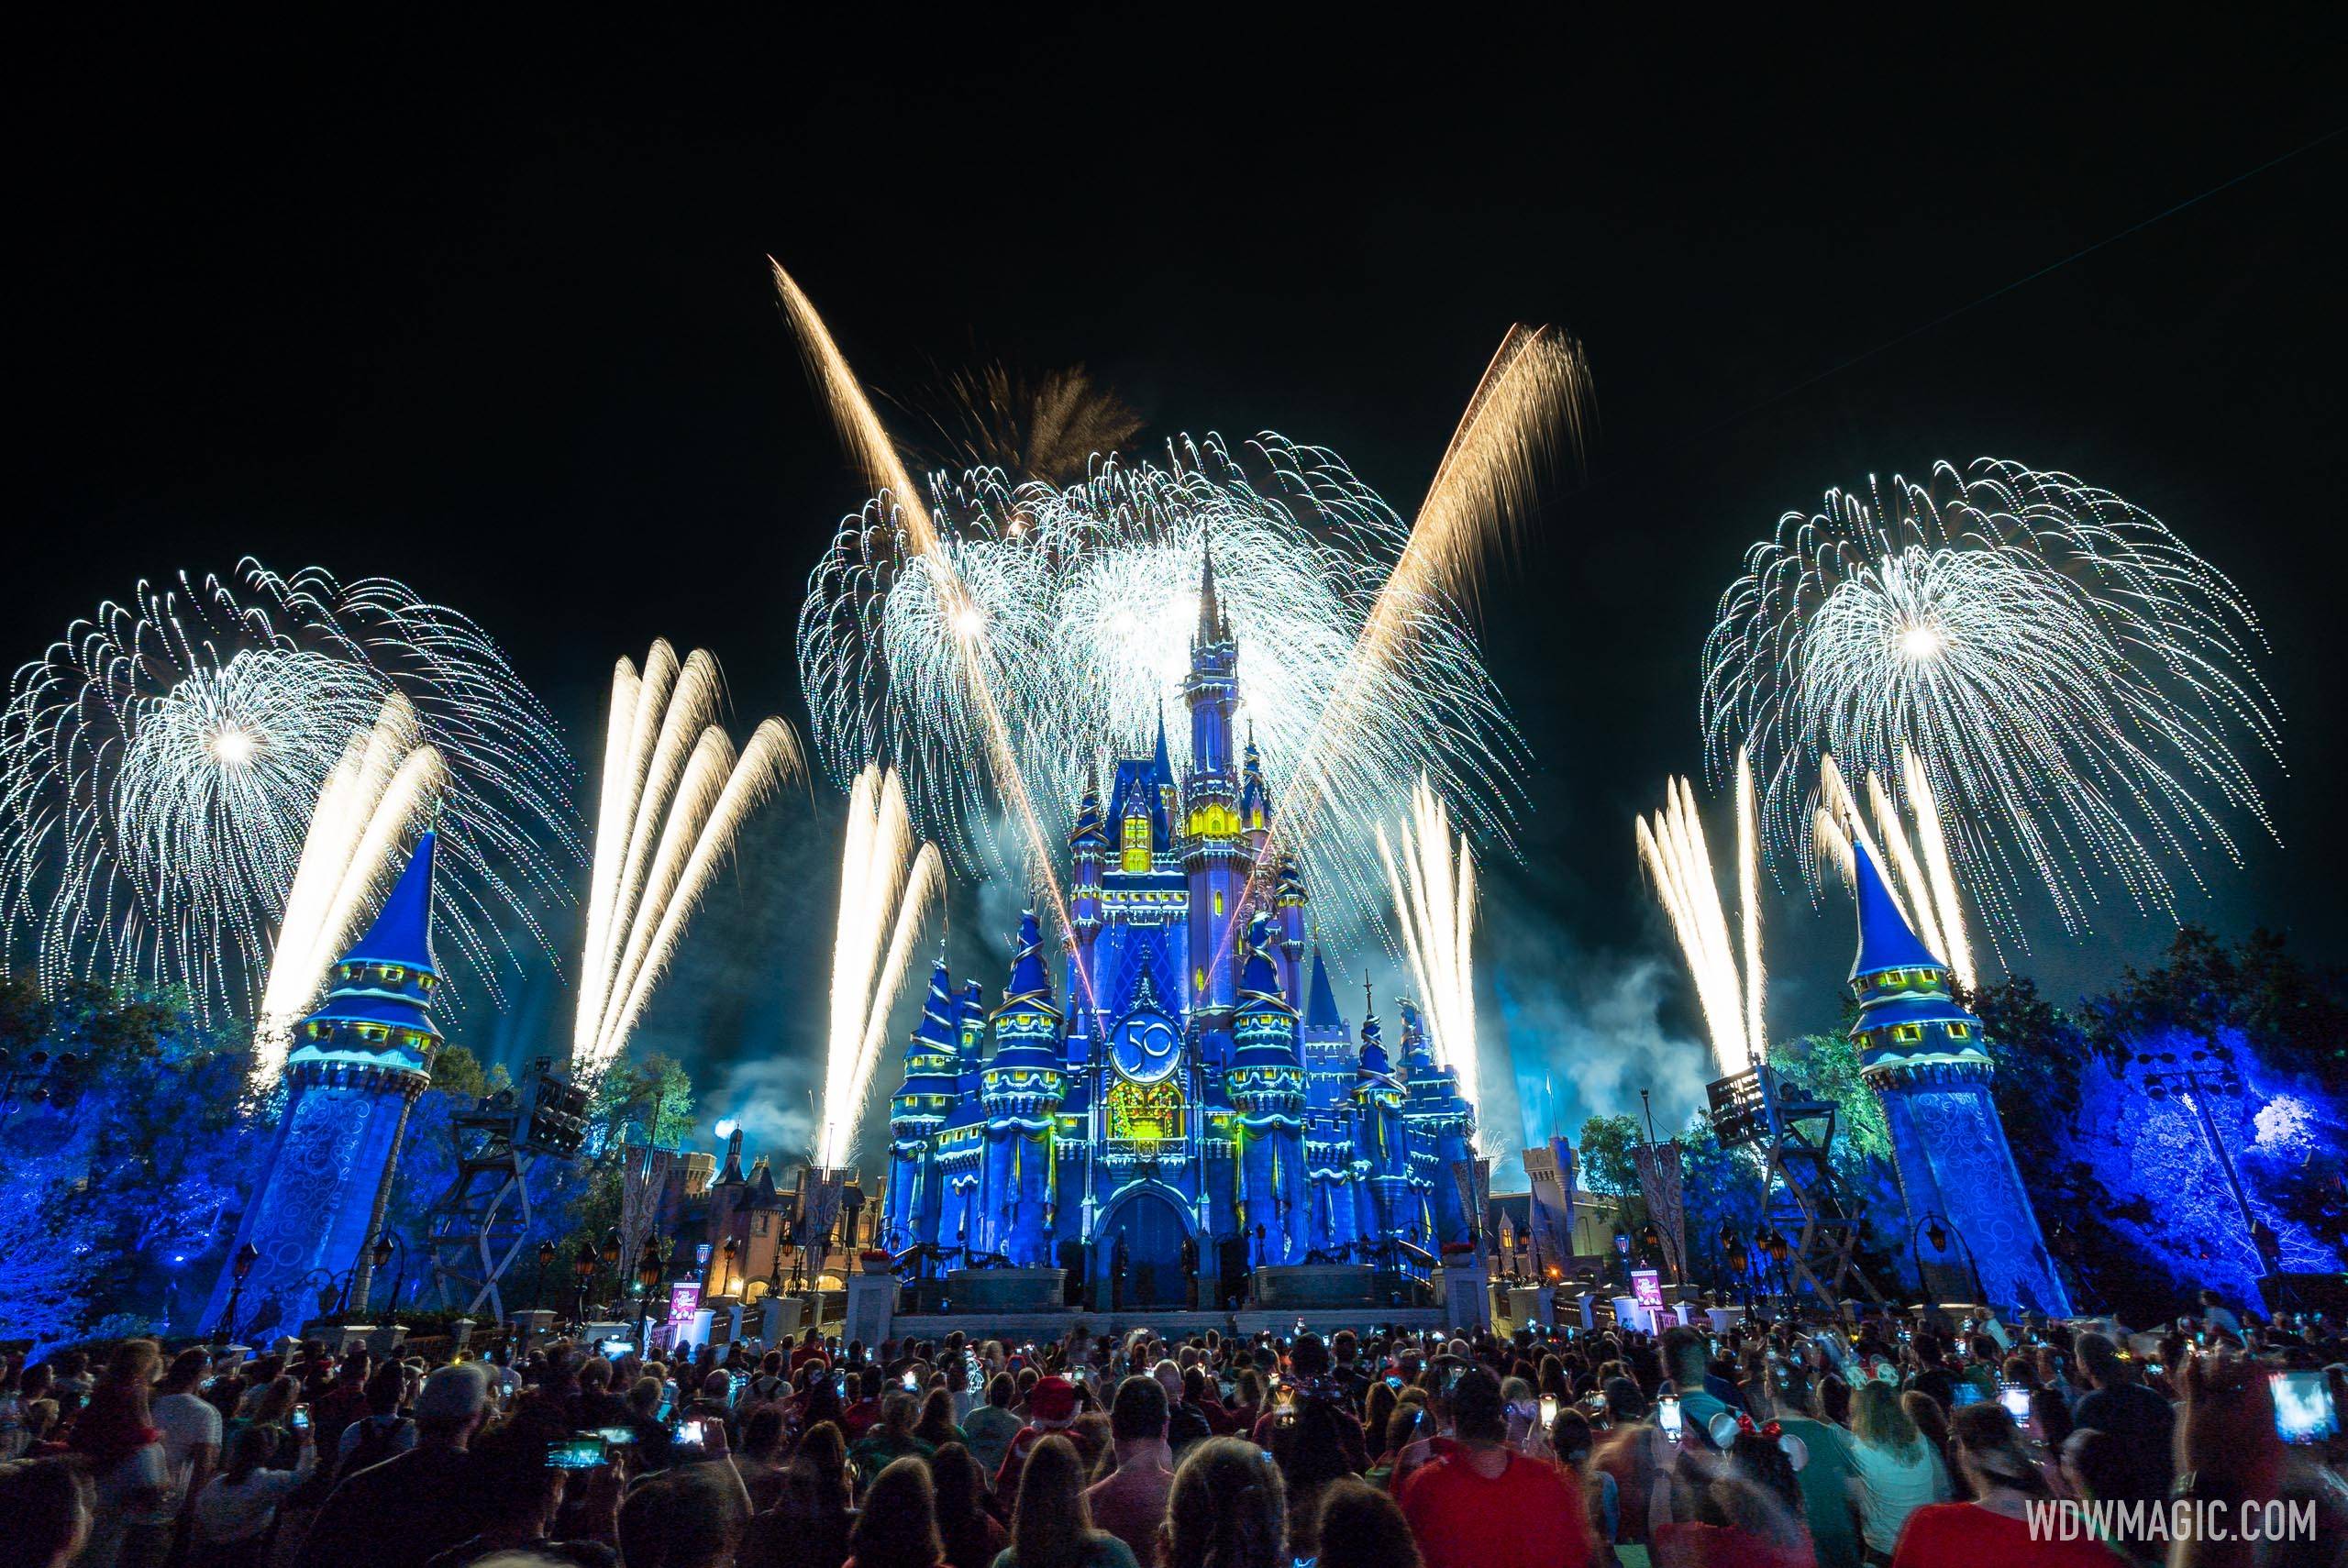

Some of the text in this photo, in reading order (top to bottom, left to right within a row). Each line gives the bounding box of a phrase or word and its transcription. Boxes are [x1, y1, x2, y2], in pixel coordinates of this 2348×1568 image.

[1126, 1020, 1172, 1074] 50
[1977, 1218, 2015, 1255] 50
[259, 1239, 304, 1278] 50
